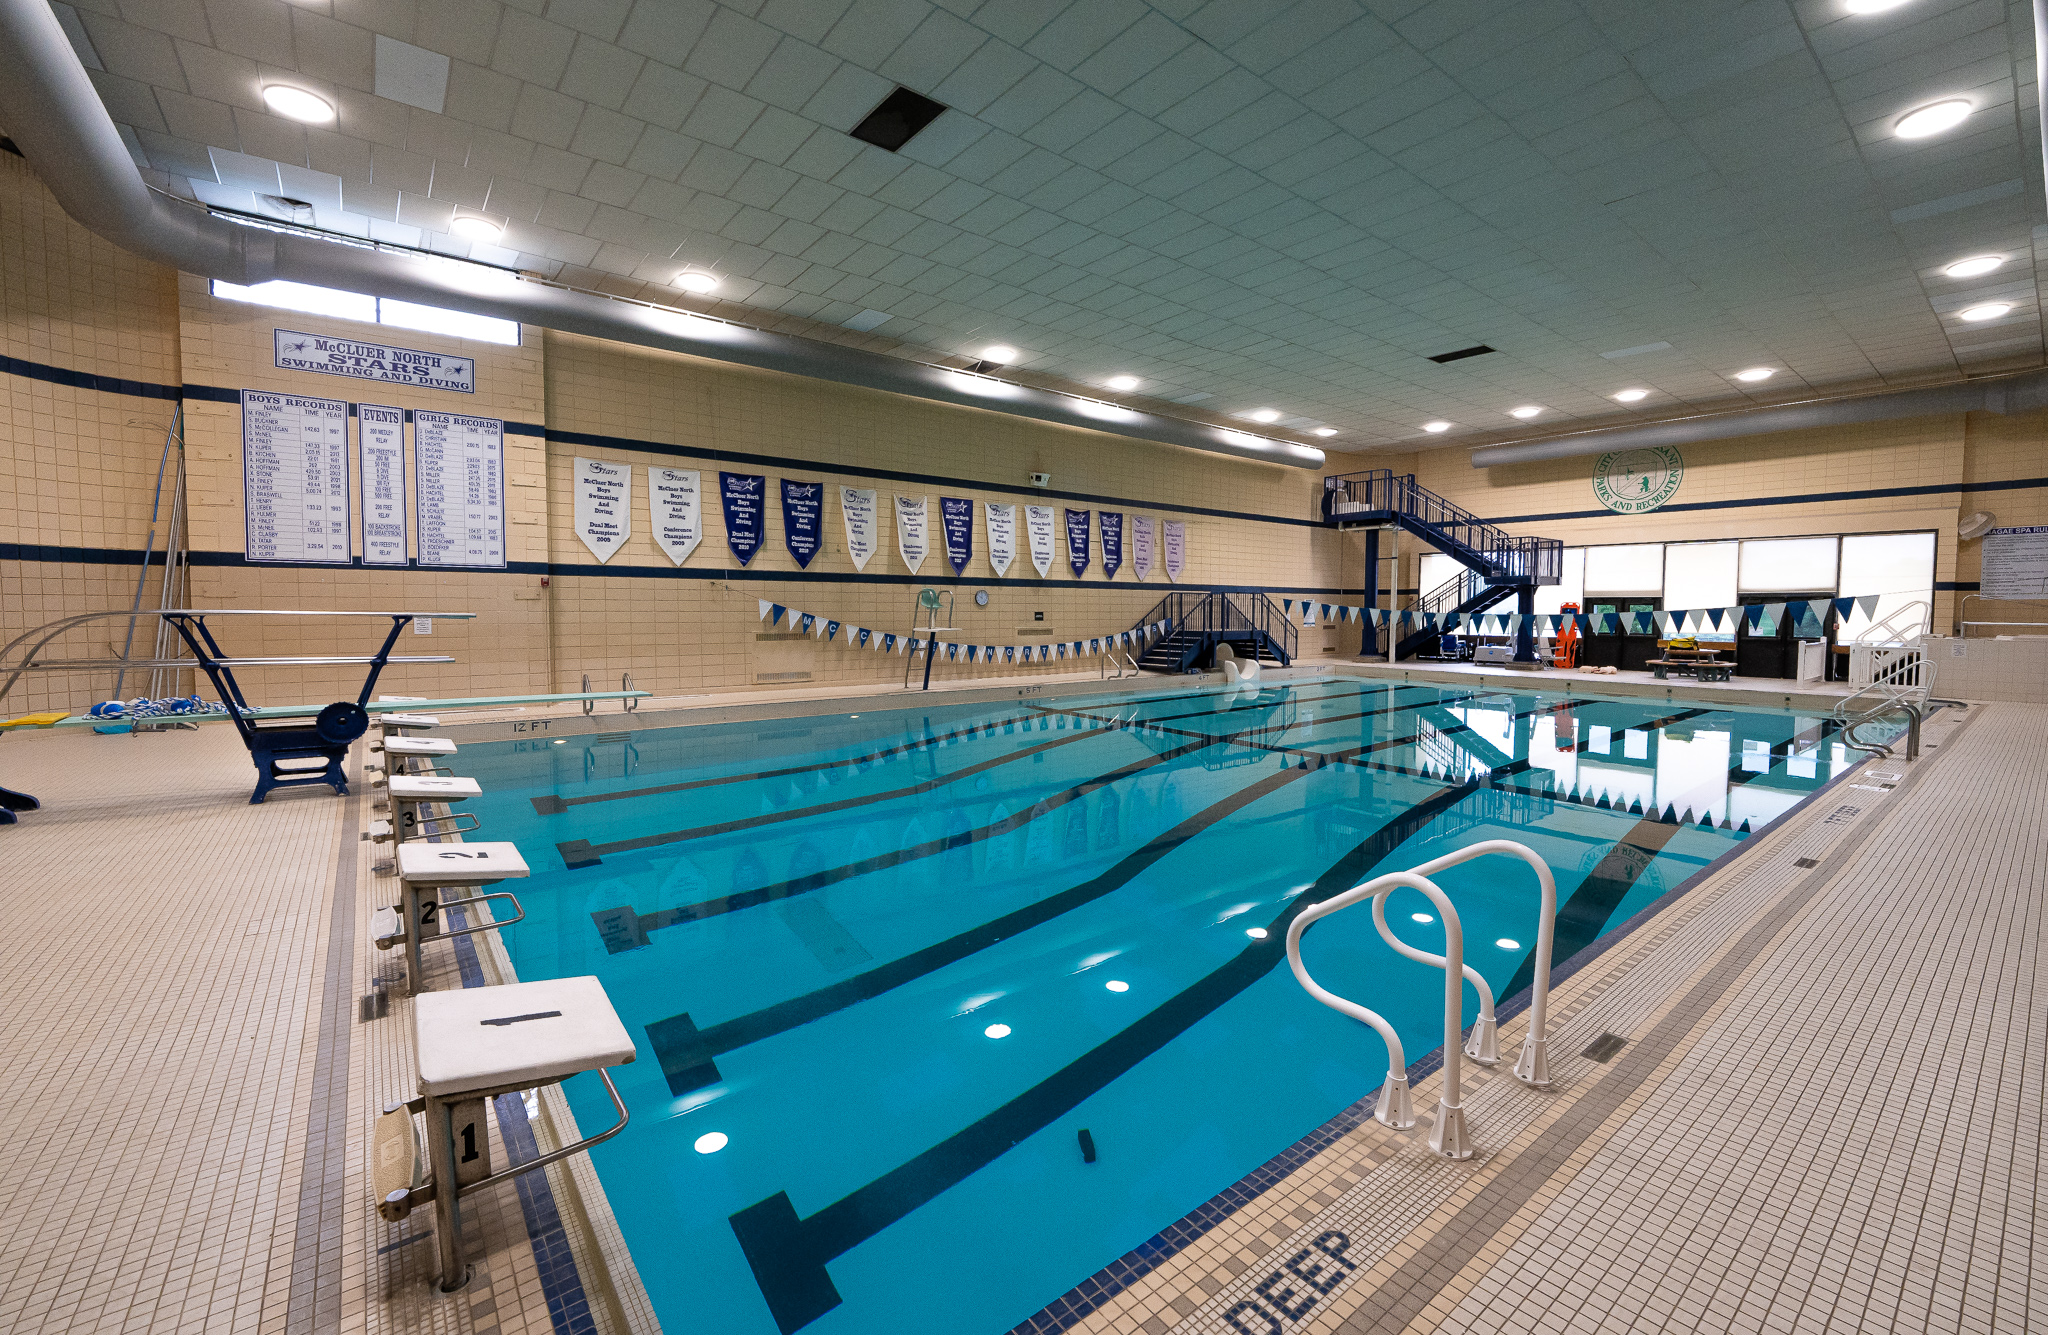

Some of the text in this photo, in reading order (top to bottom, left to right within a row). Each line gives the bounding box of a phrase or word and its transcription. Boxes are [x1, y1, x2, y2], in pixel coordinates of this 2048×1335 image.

[315, 339, 441, 368] McCLUER NORTH
[282, 358, 469, 389] SWIMMING AND DIVING
[328, 354, 429, 376] STARS
[248, 394, 342, 411] BOYS RECORDS
[364, 409, 398, 423] EVENTS
[420, 414, 498, 429] GIRLS RECORDS
[1598, 453, 1613, 472] CITY
[589, 493, 619, 501] Swimming
[1597, 469, 1680, 510] PARKS AND RECREATION
[514, 721, 551, 732] 12 FT
[396, 764, 404, 775] 4
[403, 812, 415, 827] 3
[421, 901, 437, 924] 2
[461, 1123, 479, 1163] 1
[1222, 1230, 1357, 1335] DEEP
